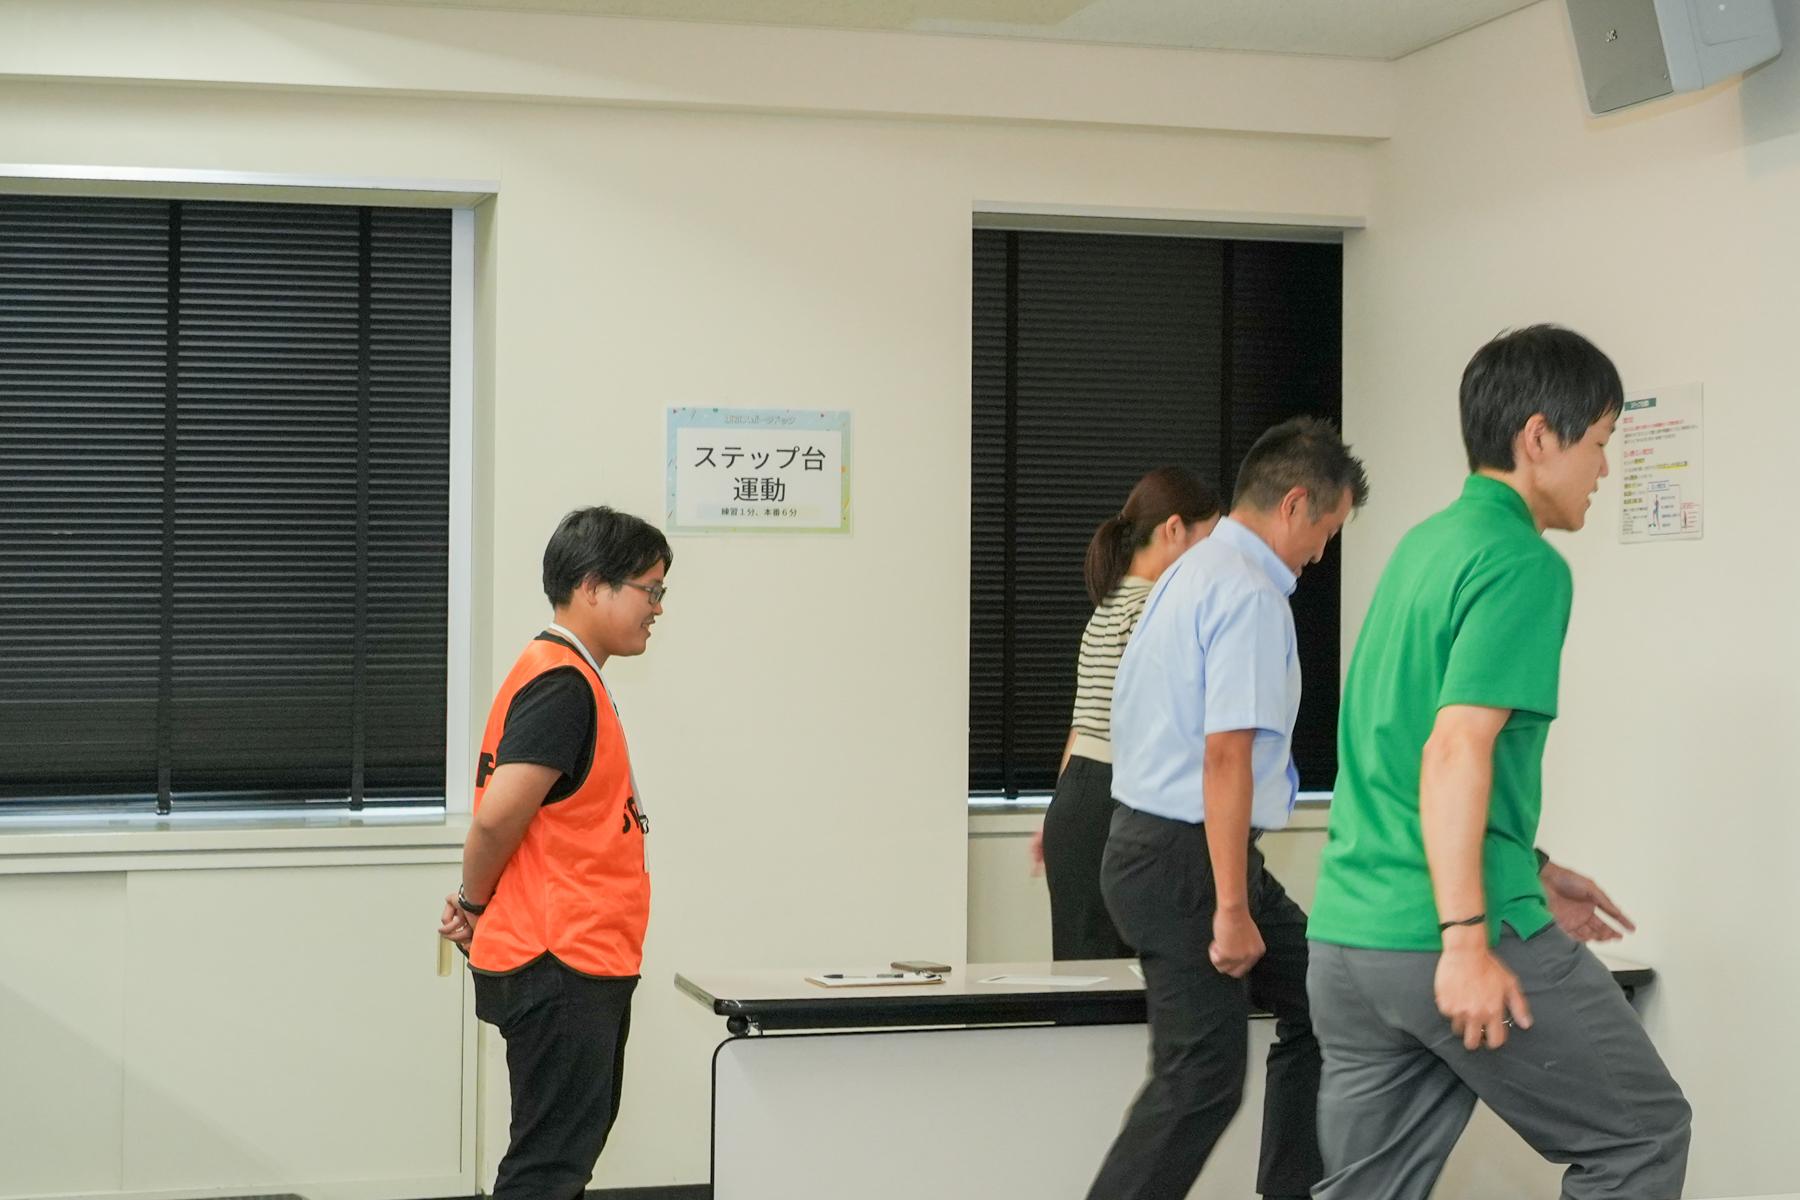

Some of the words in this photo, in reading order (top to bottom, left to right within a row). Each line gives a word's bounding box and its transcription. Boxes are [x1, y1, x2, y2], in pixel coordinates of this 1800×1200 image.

[694, 445, 826, 472] ステップ台
[733, 477, 786, 502] 運動
